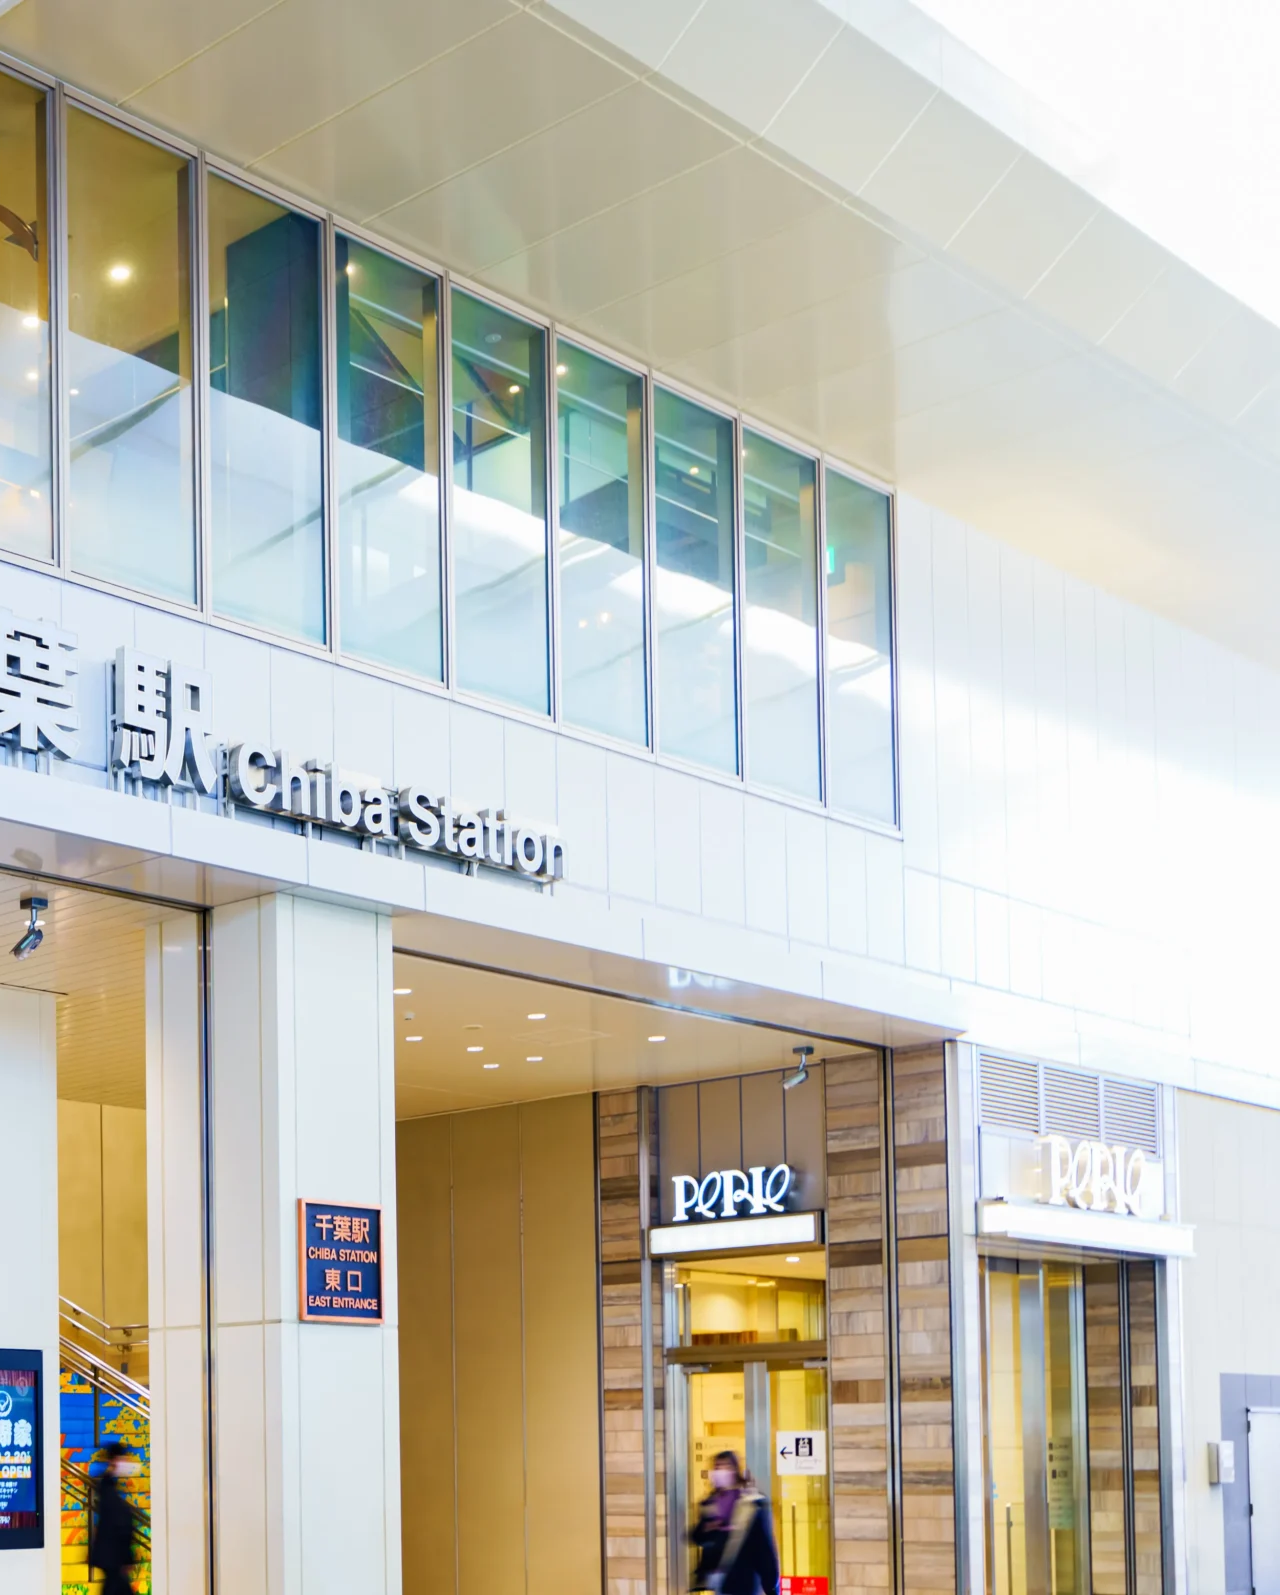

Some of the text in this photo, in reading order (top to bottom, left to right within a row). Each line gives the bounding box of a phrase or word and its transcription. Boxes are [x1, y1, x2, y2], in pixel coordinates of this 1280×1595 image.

[232, 741, 394, 838] Chiba
[402, 785, 569, 881] Station
[314, 1214, 370, 1243] 千葉駅
[308, 1246, 377, 1263] CHIBA STATION
[308, 1295, 378, 1310] EAST ENTRANCE
[1, 1465, 32, 1478] OPEN
